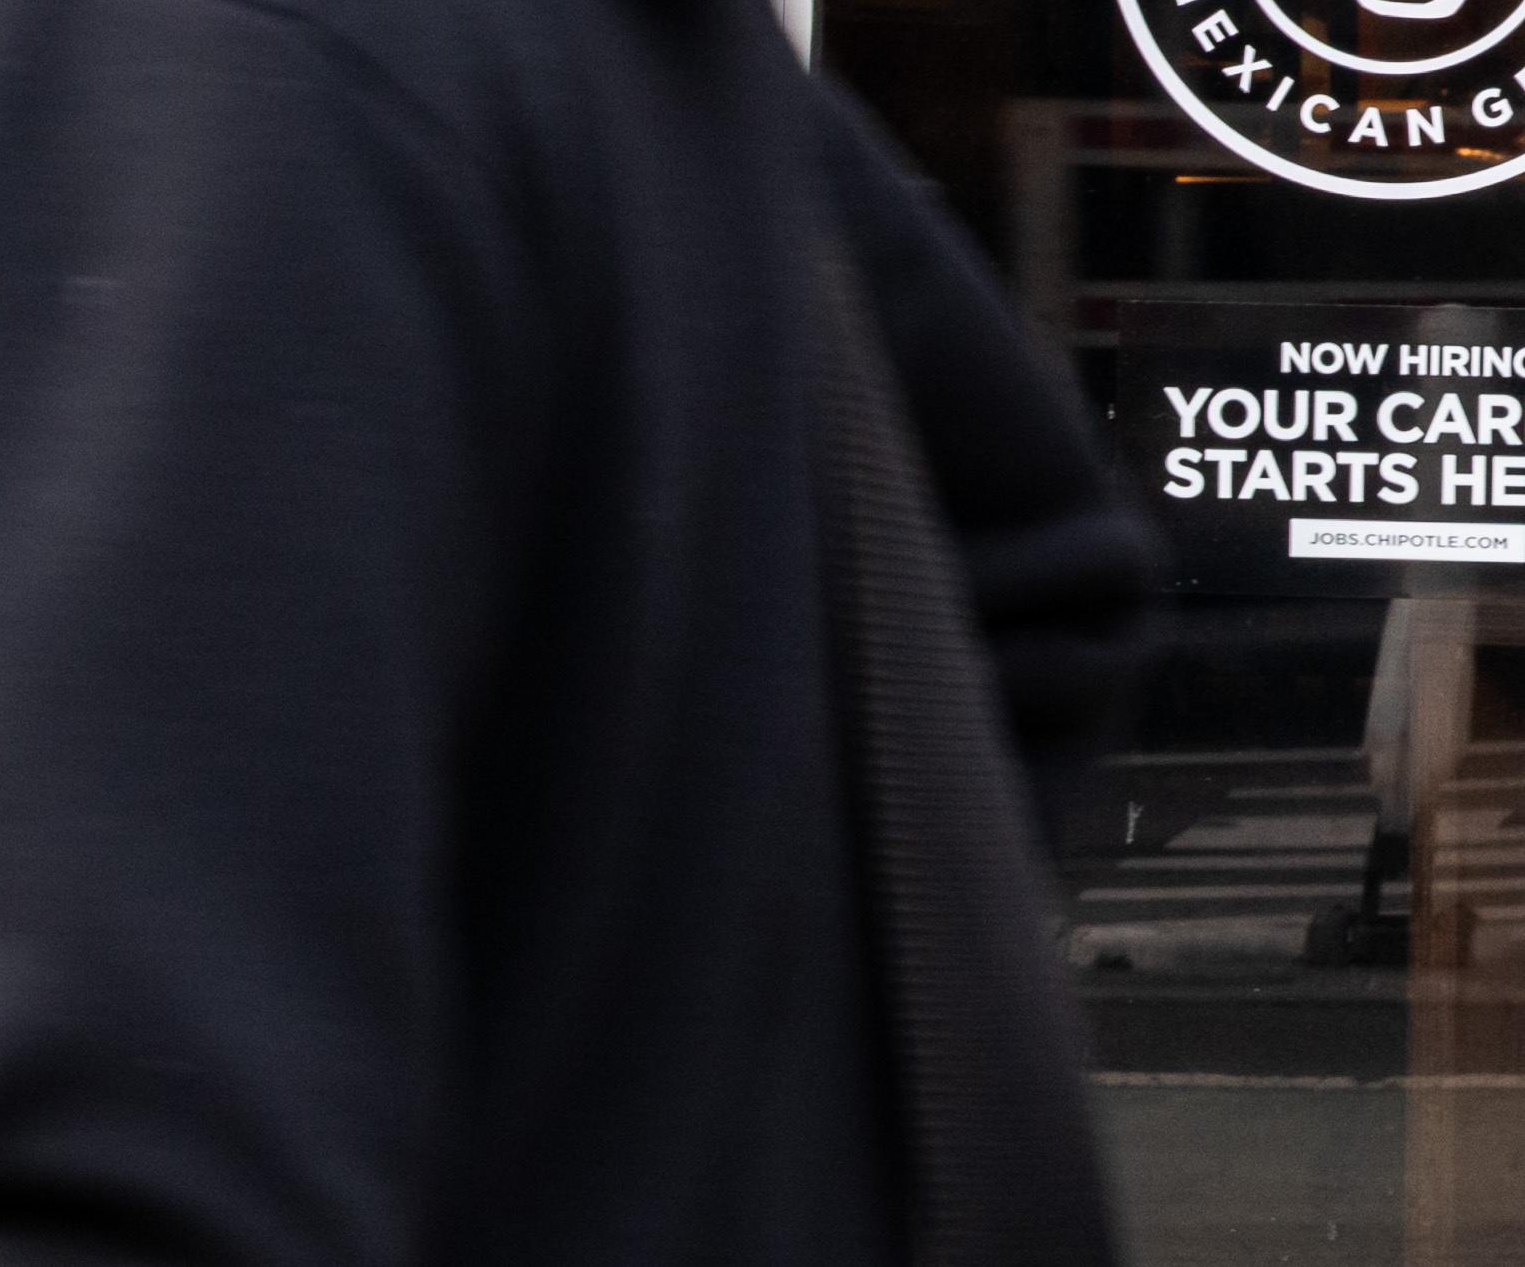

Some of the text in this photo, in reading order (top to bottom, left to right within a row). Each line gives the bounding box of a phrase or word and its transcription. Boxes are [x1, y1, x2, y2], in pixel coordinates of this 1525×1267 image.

[1471, 65, 1525, 123] G
[1280, 341, 1389, 375] NOW
[1163, 386, 1358, 442] YOUR
[1163, 447, 1525, 507] STARTS HE
[1309, 532, 1509, 550] JOBS.CHIPOTLE.COM
